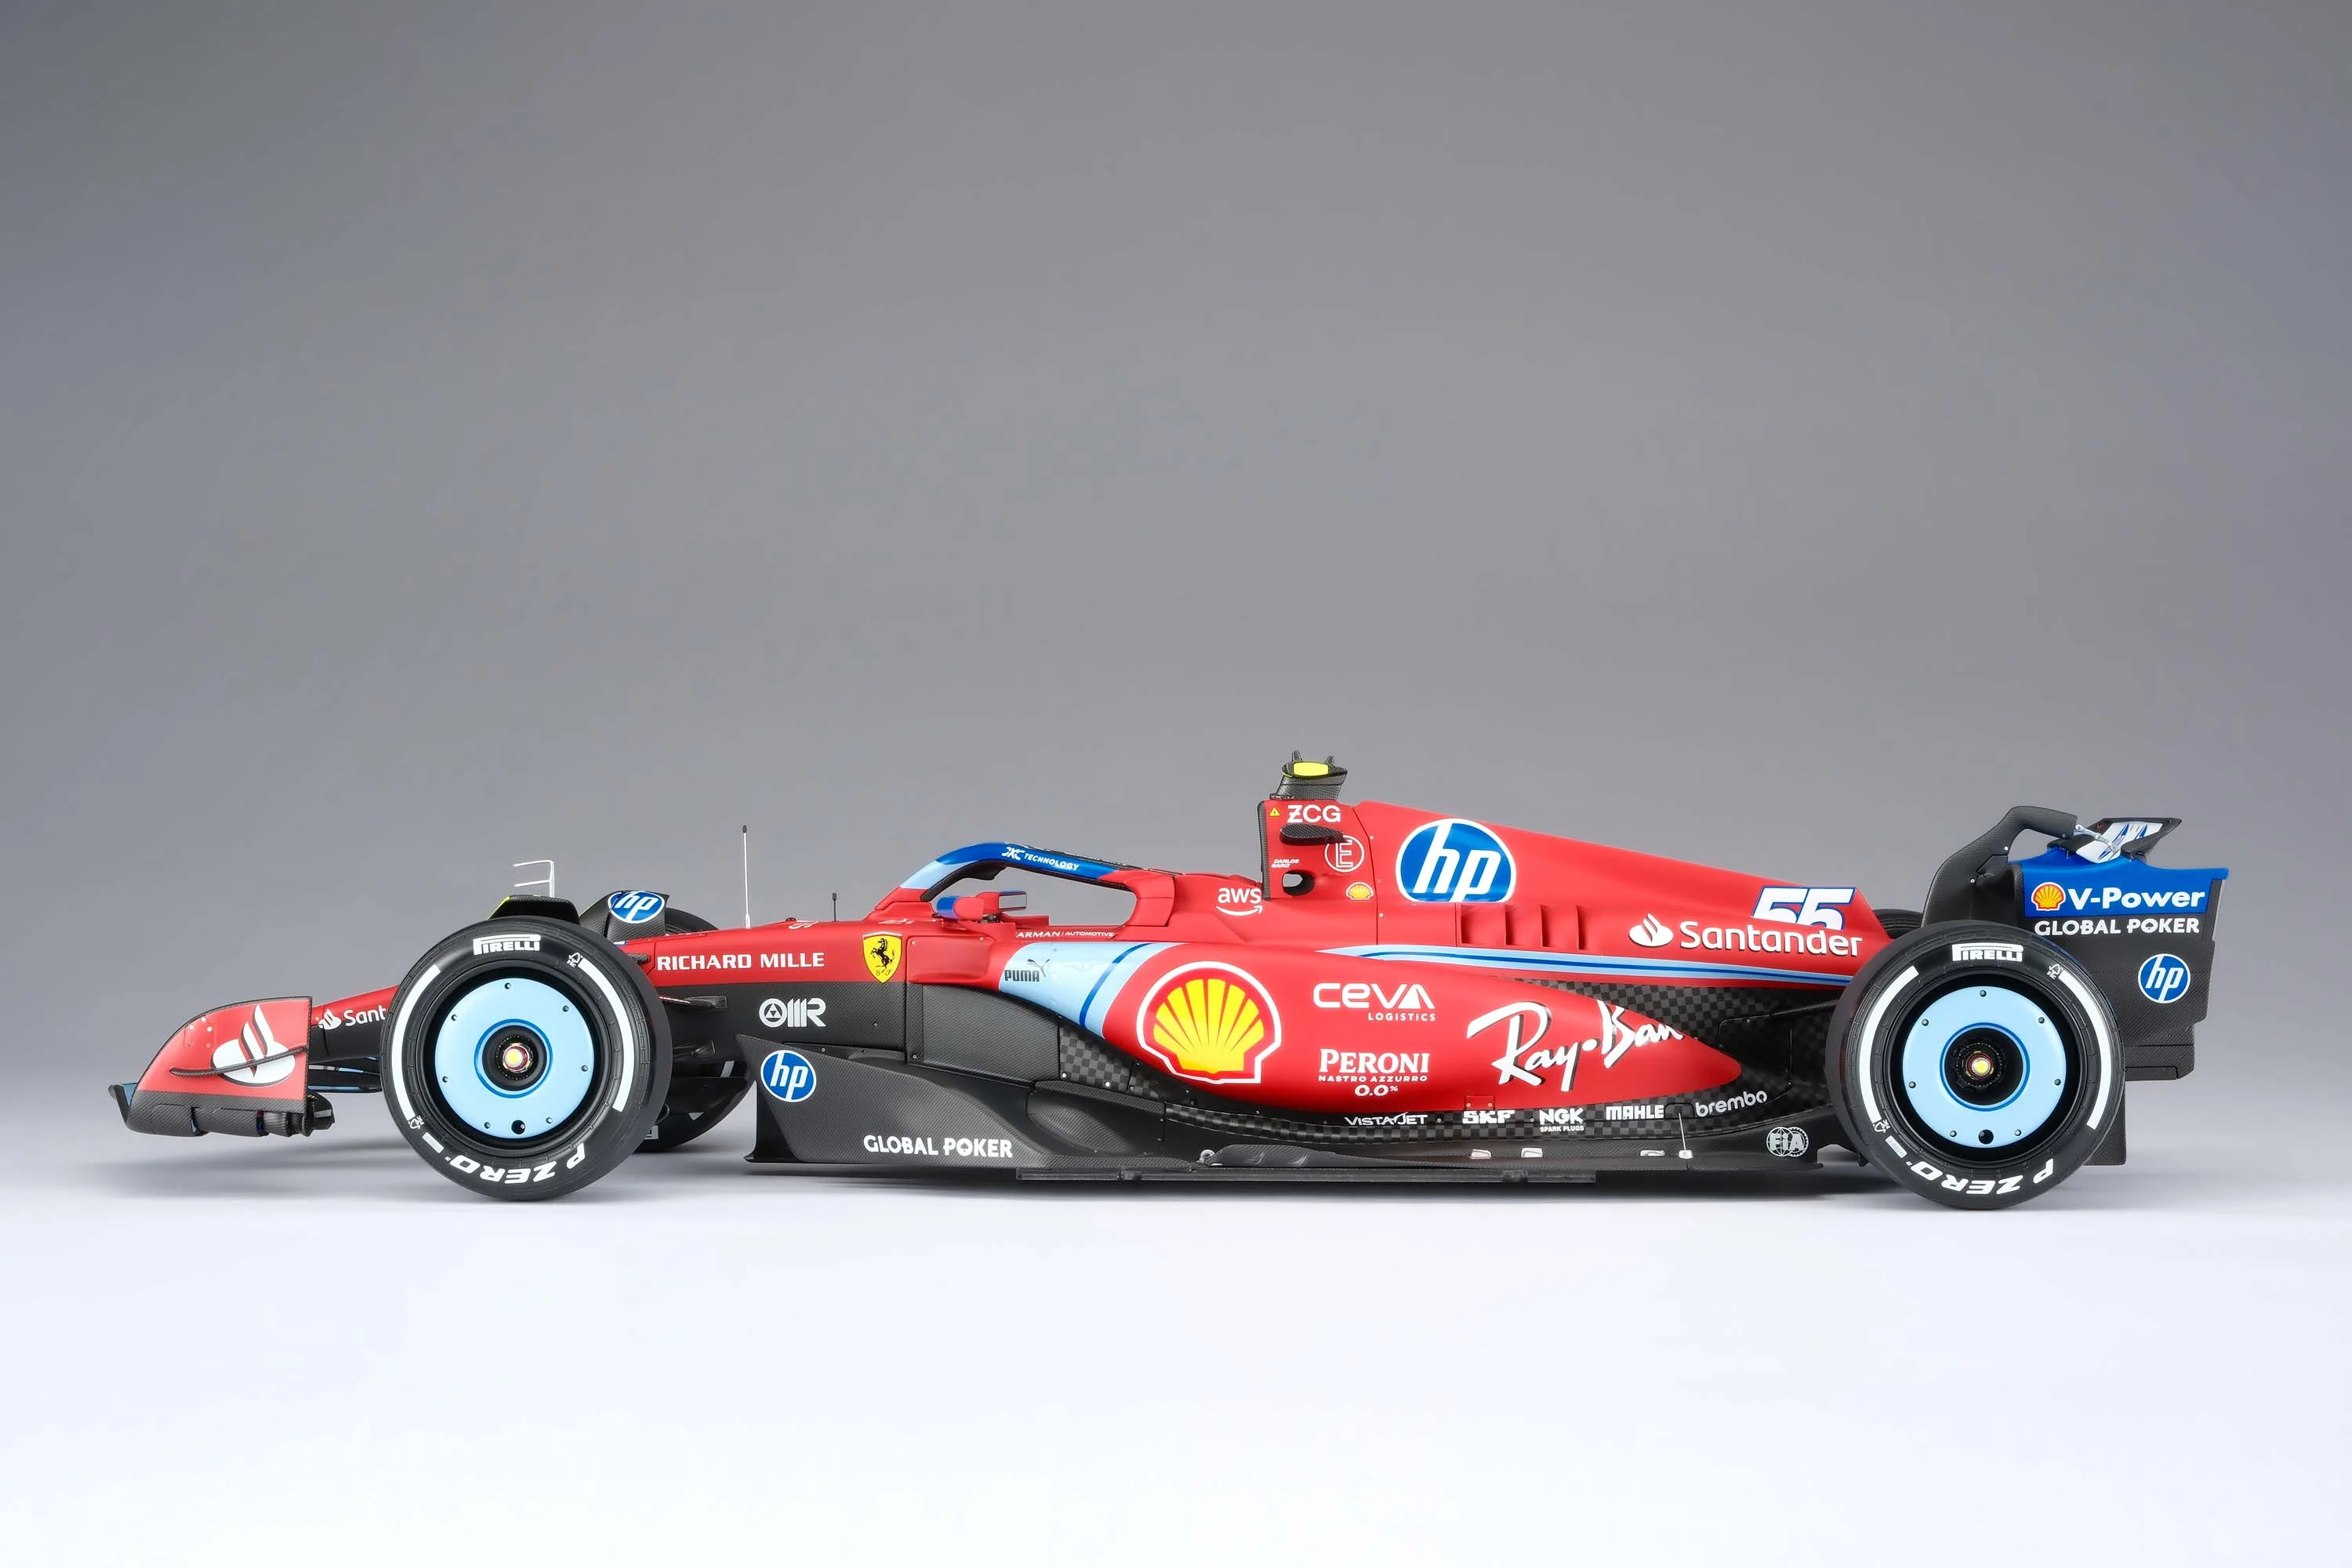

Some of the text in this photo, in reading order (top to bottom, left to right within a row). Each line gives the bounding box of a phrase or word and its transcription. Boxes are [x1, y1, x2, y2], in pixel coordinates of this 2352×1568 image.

[1024, 853, 1080, 871] TECHNOLOGY
[1413, 819, 1501, 902] hp
[1218, 887, 1261, 903] aws
[2067, 887, 2205, 910] V-Power
[615, 891, 659, 924] hp
[1751, 885, 1857, 931] 55
[1679, 920, 1863, 956] Santander
[2034, 918, 2200, 936] GLOBAL POKER
[473, 934, 542, 956] PIRELLI
[1952, 942, 2024, 962] PIRELLI
[657, 952, 825, 971] RICHARD MILLE
[1004, 970, 1040, 982] PUMA
[2144, 955, 2184, 1004] hp
[1368, 1012, 1436, 1022] LOGISTICS
[1319, 1048, 1431, 1073] PERONI
[770, 1051, 809, 1101] hp
[1606, 1105, 1664, 1120] MAHLE
[1695, 1091, 1768, 1117] brembo
[1462, 1109, 1515, 1124] SKF
[1539, 1108, 1584, 1125] NGK
[863, 1134, 1013, 1158] GLOBAL POKER
[450, 1142, 586, 1185] P ZERO
[1911, 1158, 2055, 1195] P ZERO
